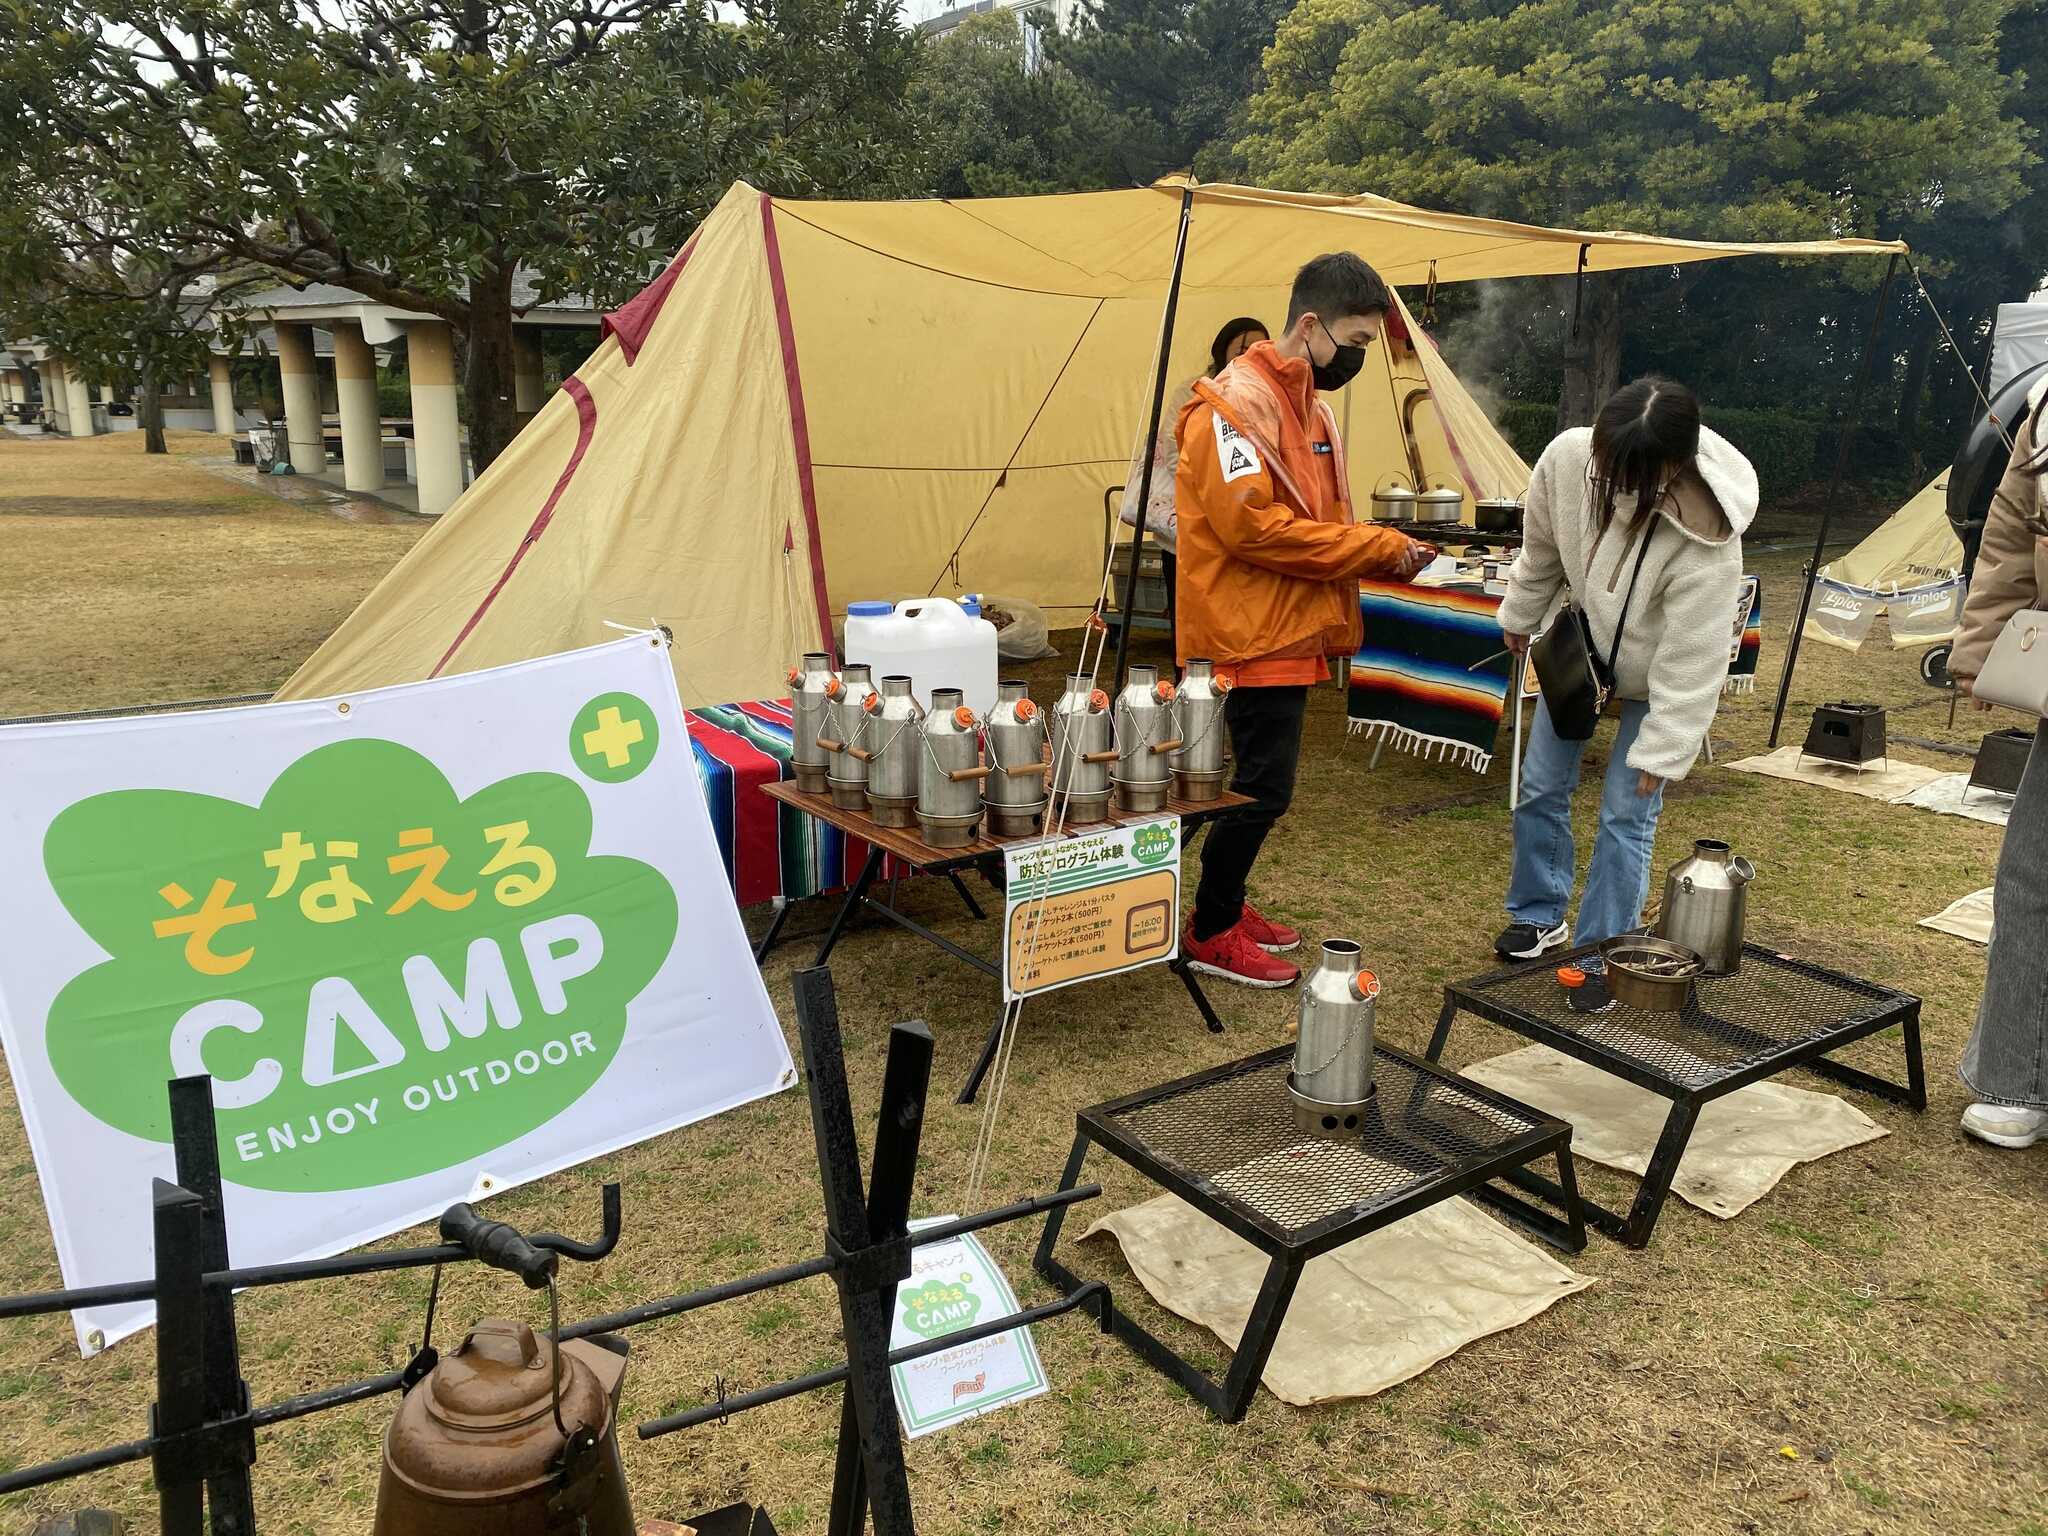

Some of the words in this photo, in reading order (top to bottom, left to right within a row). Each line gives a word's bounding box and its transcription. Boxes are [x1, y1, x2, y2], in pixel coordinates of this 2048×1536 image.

[1826, 590, 1863, 611] Ziploc
[1910, 590, 1949, 608] Ziploc
[1138, 842, 1169, 857] CAMP
[152, 820, 557, 975] そなえる
[170, 914, 604, 1109] CAMP
[235, 1098, 379, 1161] ENJOY
[403, 1031, 596, 1111] OUTDOOR
[912, 1287, 963, 1311] そなえる
[916, 1300, 972, 1329] CAMP
